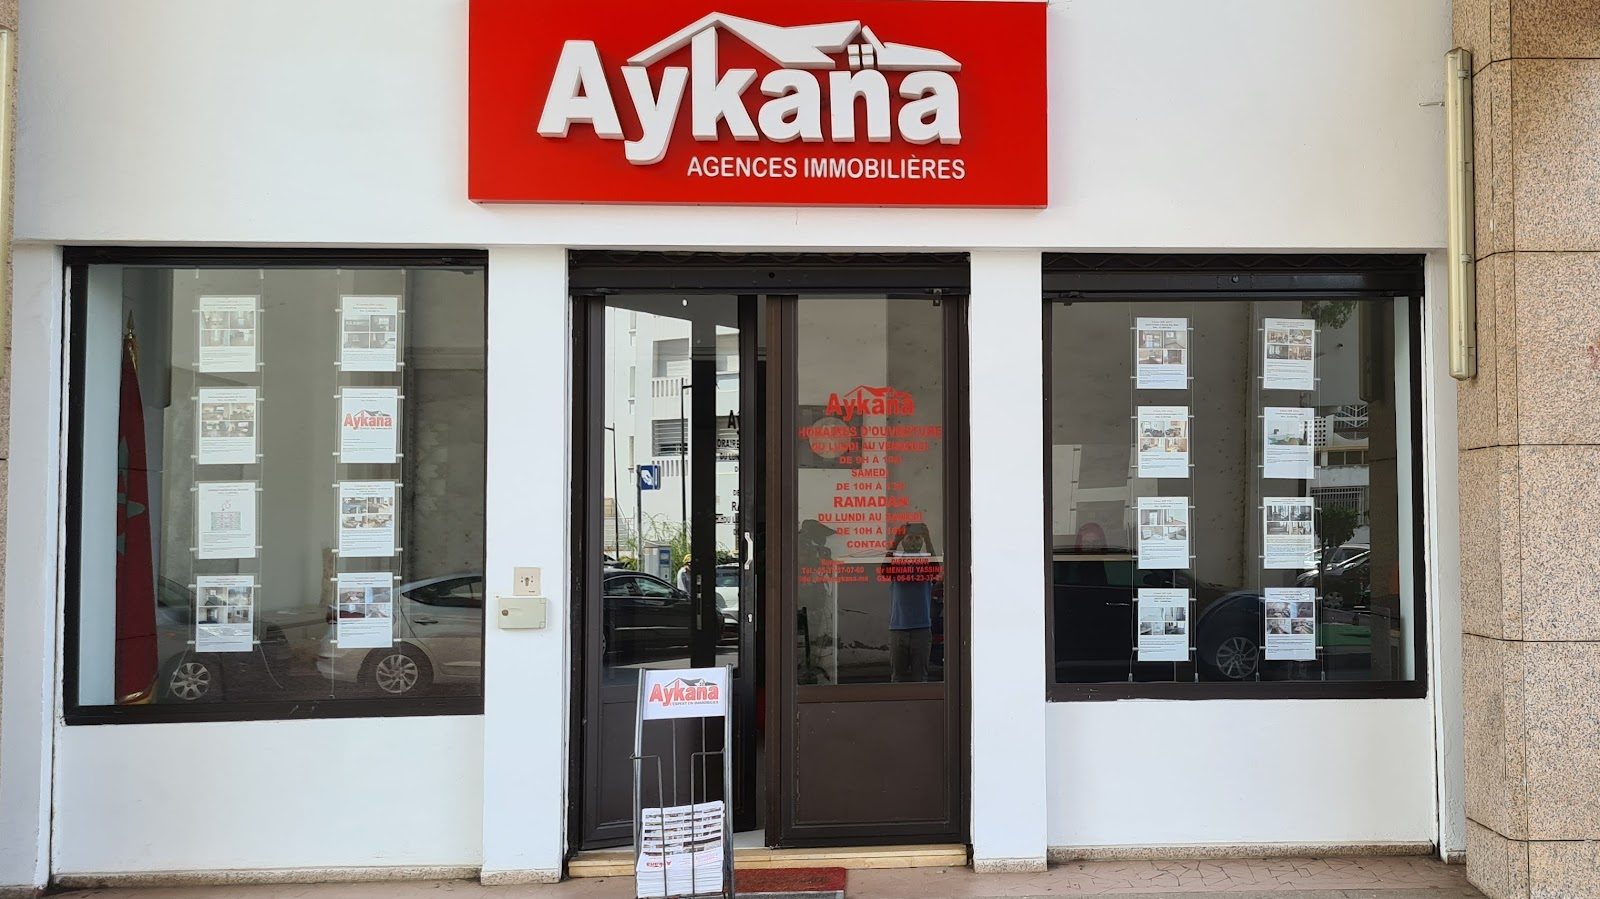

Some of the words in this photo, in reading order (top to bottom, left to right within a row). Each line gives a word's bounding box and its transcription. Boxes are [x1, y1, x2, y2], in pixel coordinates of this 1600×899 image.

[536, 26, 962, 166] Aykana
[686, 156, 797, 179] AGENCES
[803, 154, 966, 180] IMMOBILIÈRES
[825, 388, 915, 422] Aykana
[343, 410, 393, 430] Aykana
[862, 441, 875, 451] AU
[839, 455, 852, 465] DE
[851, 468, 889, 477] SAMEDI
[836, 482, 850, 490] DE
[854, 482, 872, 490] 10H
[833, 496, 909, 508] RAMADAN
[818, 513, 832, 522] DU
[835, 513, 865, 522] LUNDI
[868, 513, 882, 522] AU
[836, 526, 850, 535] DE
[854, 526, 872, 535] 10H
[649, 679, 719, 707] Aykana
